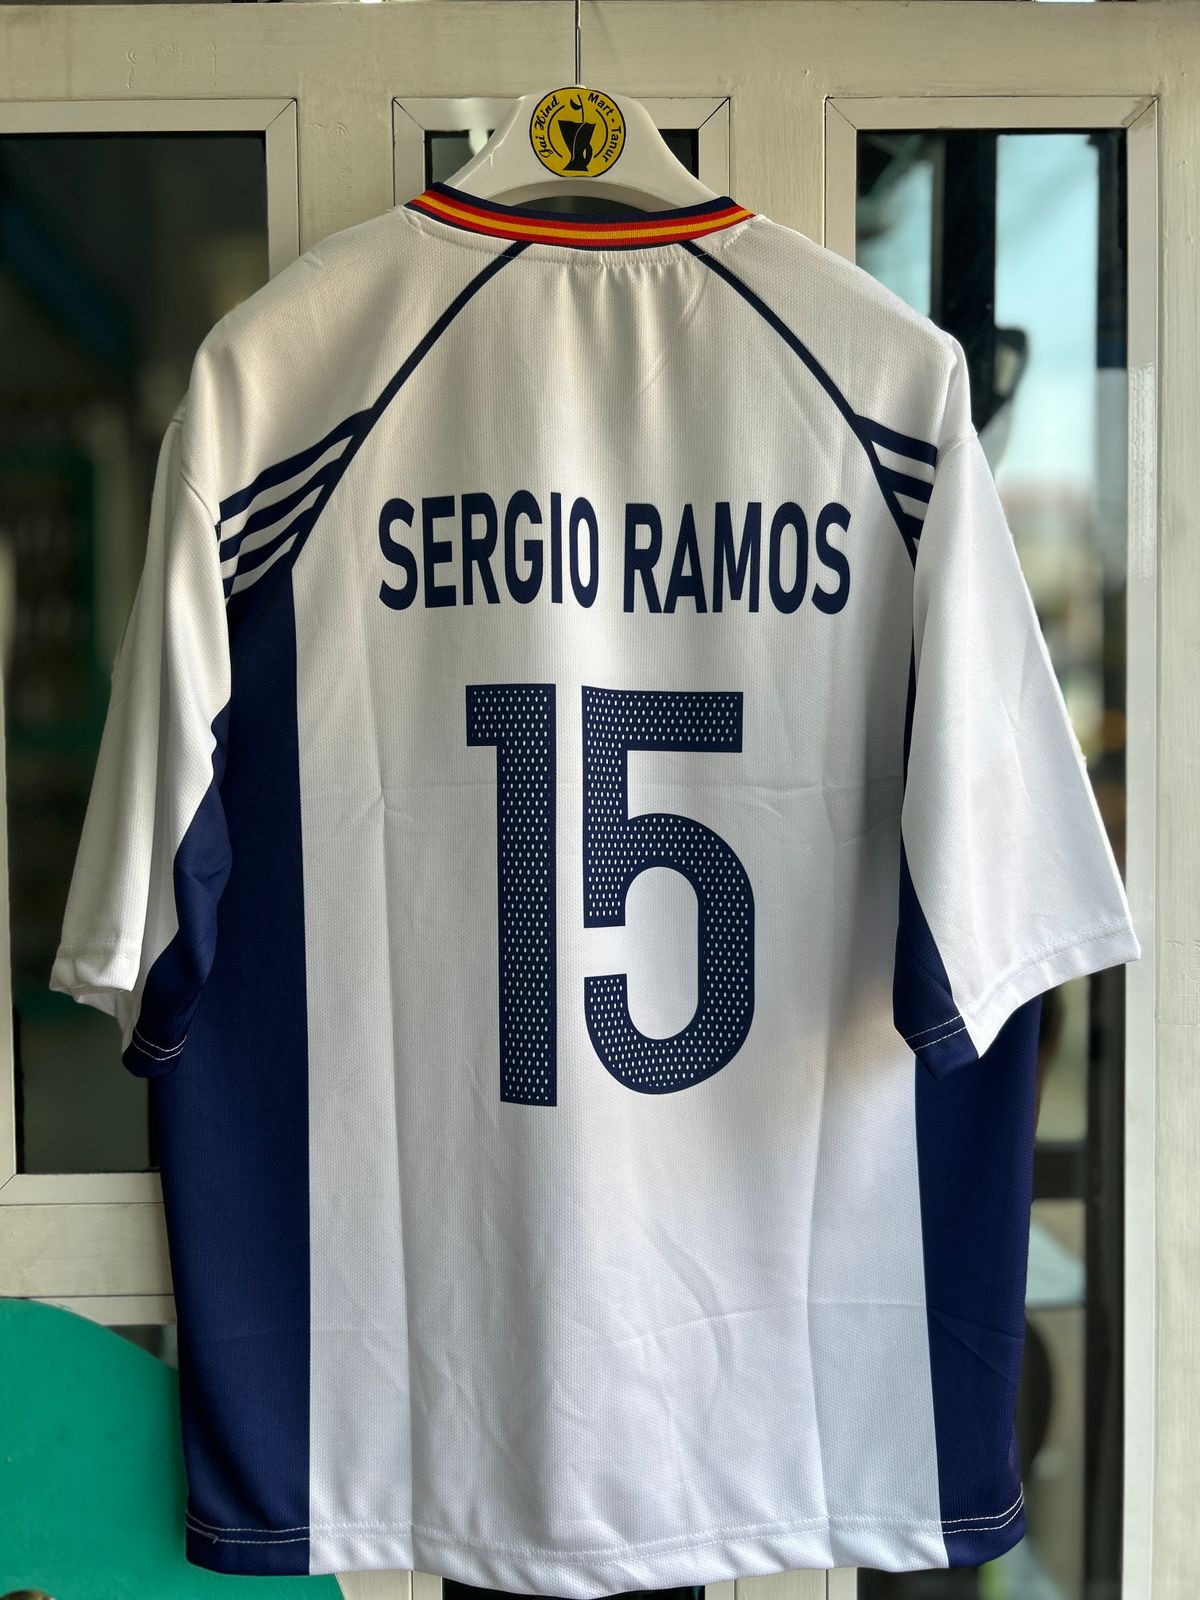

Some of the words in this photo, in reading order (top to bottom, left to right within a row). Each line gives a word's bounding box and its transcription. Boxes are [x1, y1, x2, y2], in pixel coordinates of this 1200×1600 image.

[534, 95, 560, 130] Hind
[587, 93, 614, 116] Mart
[535, 135, 554, 158] Jai
[602, 126, 622, 163] Tanur
[379, 490, 599, 611] SERGIO
[623, 501, 852, 615] RAMOS
[465, 683, 756, 1108] 15
